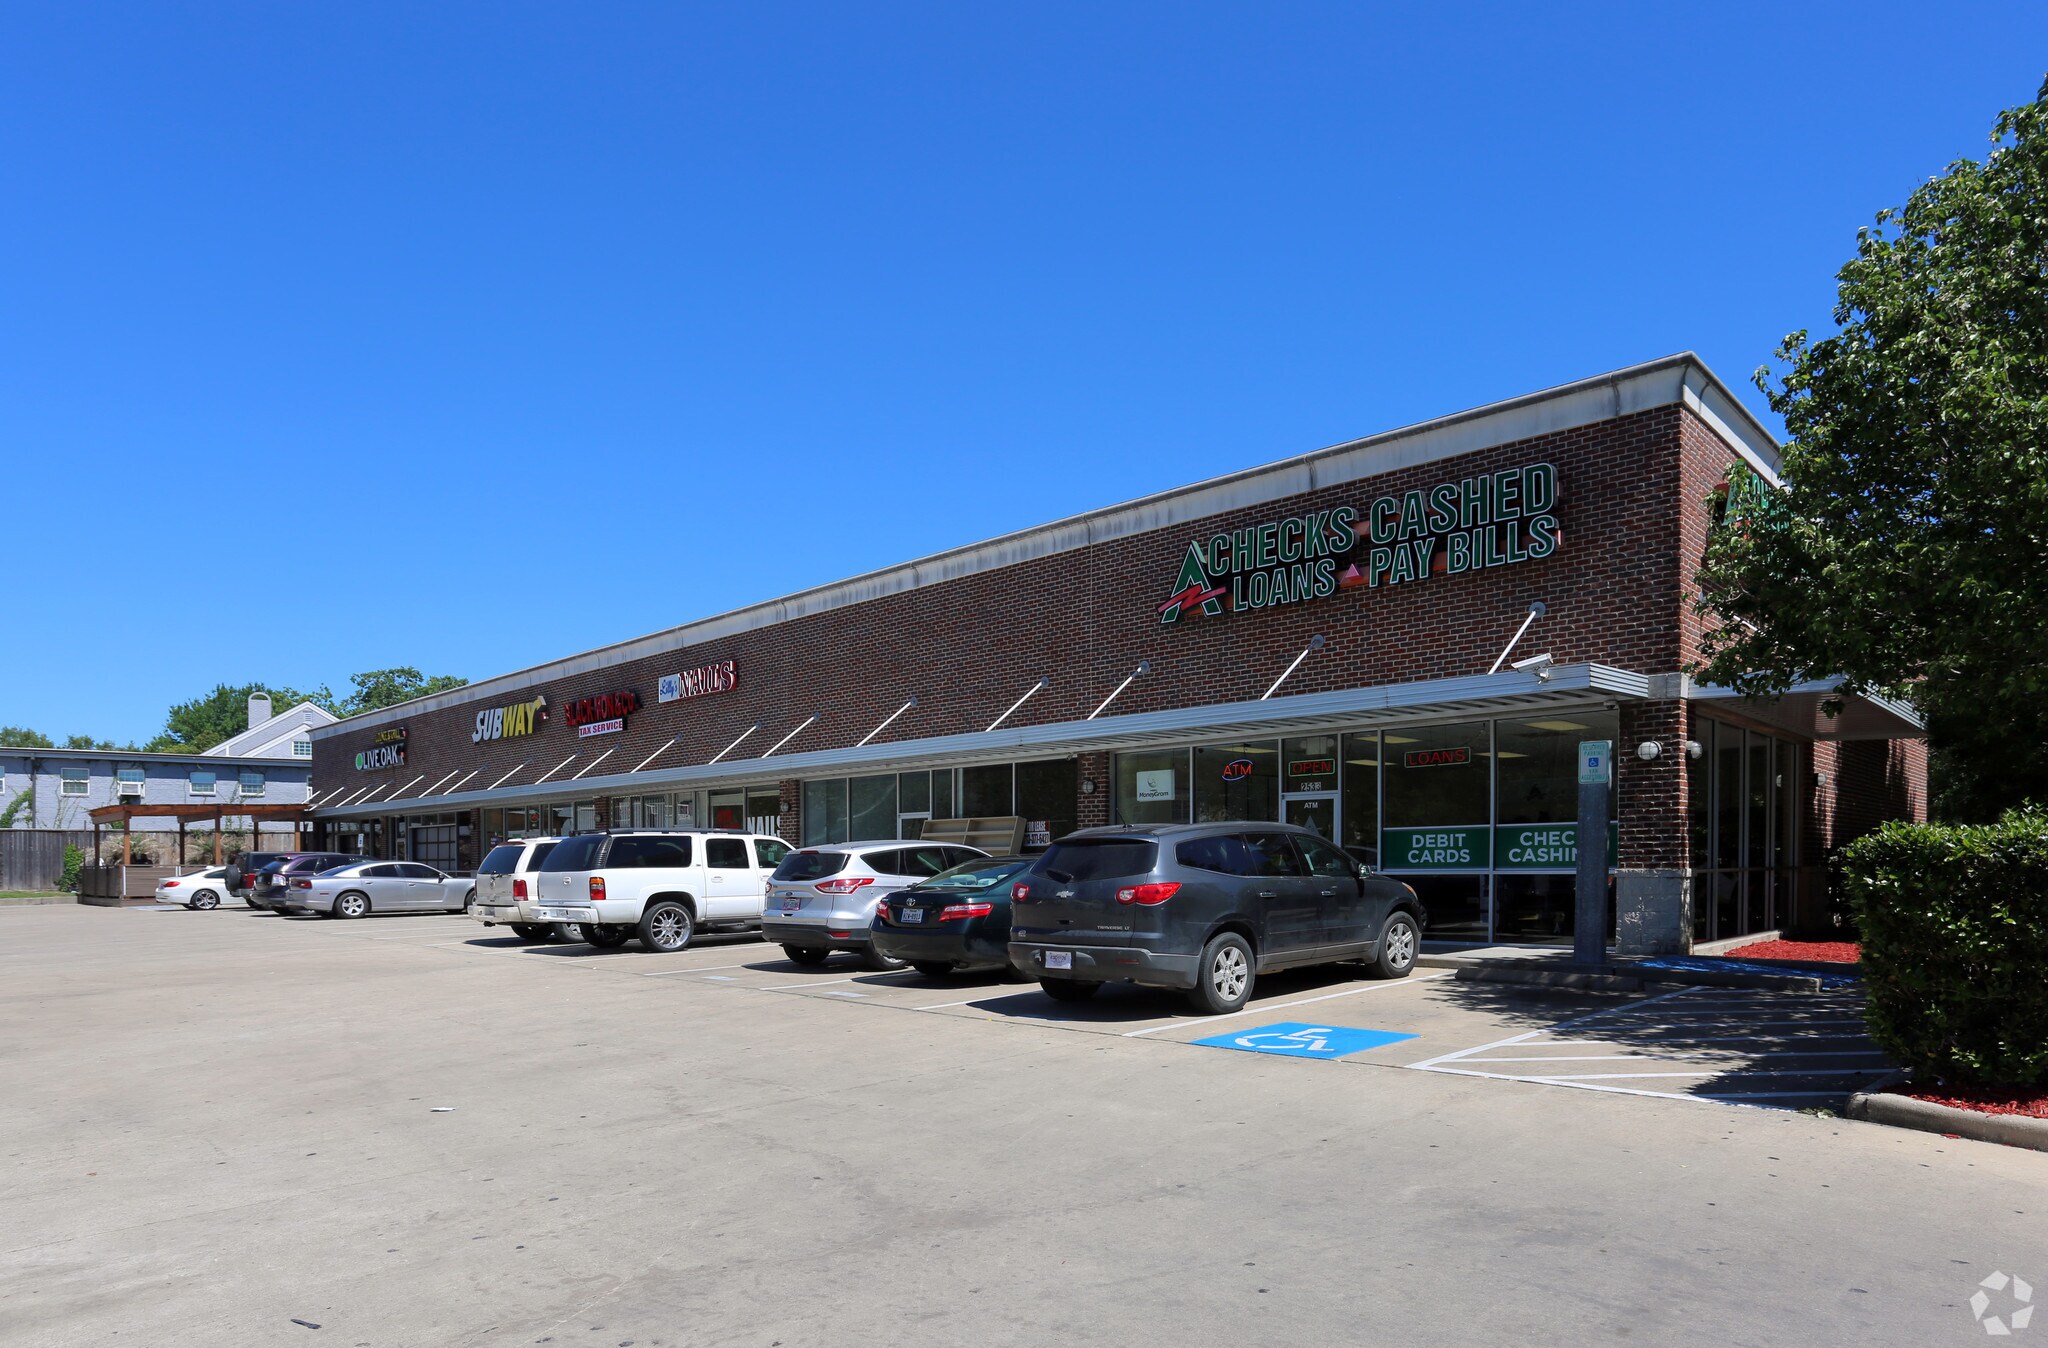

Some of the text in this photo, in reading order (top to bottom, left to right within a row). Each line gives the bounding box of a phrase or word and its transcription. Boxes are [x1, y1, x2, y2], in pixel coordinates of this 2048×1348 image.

[1207, 462, 1557, 577] CHECKS CASHED
[1233, 514, 1559, 613] LOANS PAY BILLS
[678, 660, 736, 698] NAILS
[472, 696, 546, 743] SUBWAY
[579, 720, 623, 736] TAX SERVICE
[362, 744, 398, 769] LIVE OAK
[1408, 749, 1466, 766] LOANS
[1223, 763, 1253, 777] ATM
[1292, 761, 1331, 774] OPEN
[1301, 782, 1321, 792] 2533
[1034, 821, 1046, 831] LEASE
[1412, 833, 1466, 848] DEBIT
[1520, 831, 1575, 846] CHEC
[1408, 849, 1471, 864] CARDS
